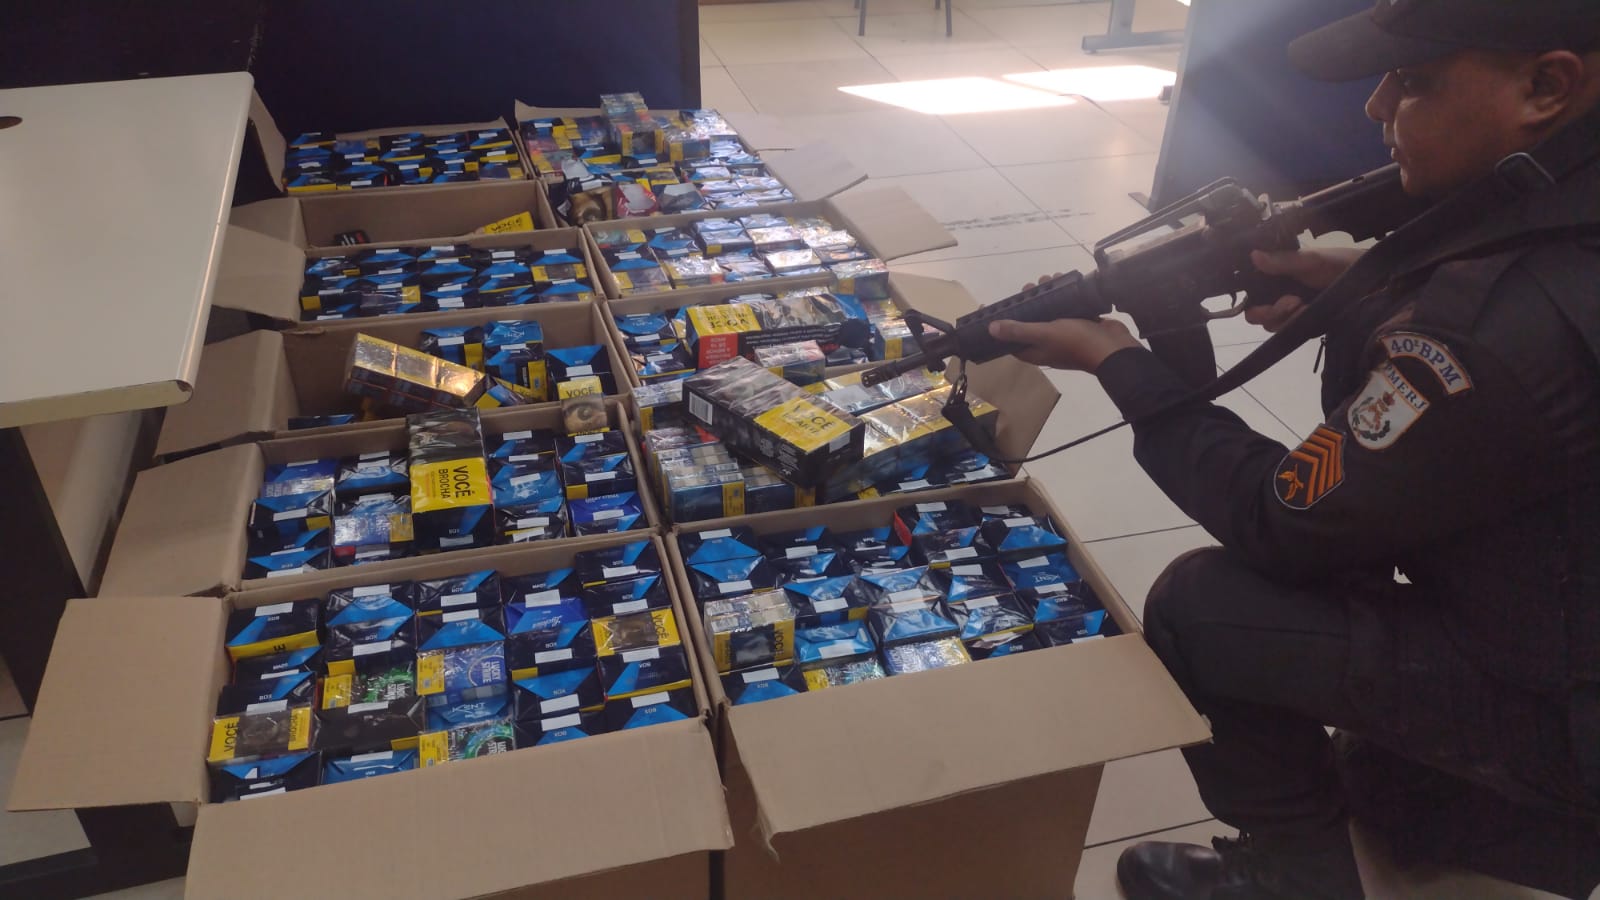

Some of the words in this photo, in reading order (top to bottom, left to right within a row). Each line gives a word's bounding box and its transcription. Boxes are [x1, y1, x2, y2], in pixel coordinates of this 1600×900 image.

[1386, 363, 1427, 409] PMERJ
[438, 467, 452, 499] BROCHA
[452, 464, 476, 498] VOCÊ
[481, 661, 492, 683] STRIKE
[491, 659, 501, 682] LUCKY
[223, 721, 240, 753] VOCÊ
